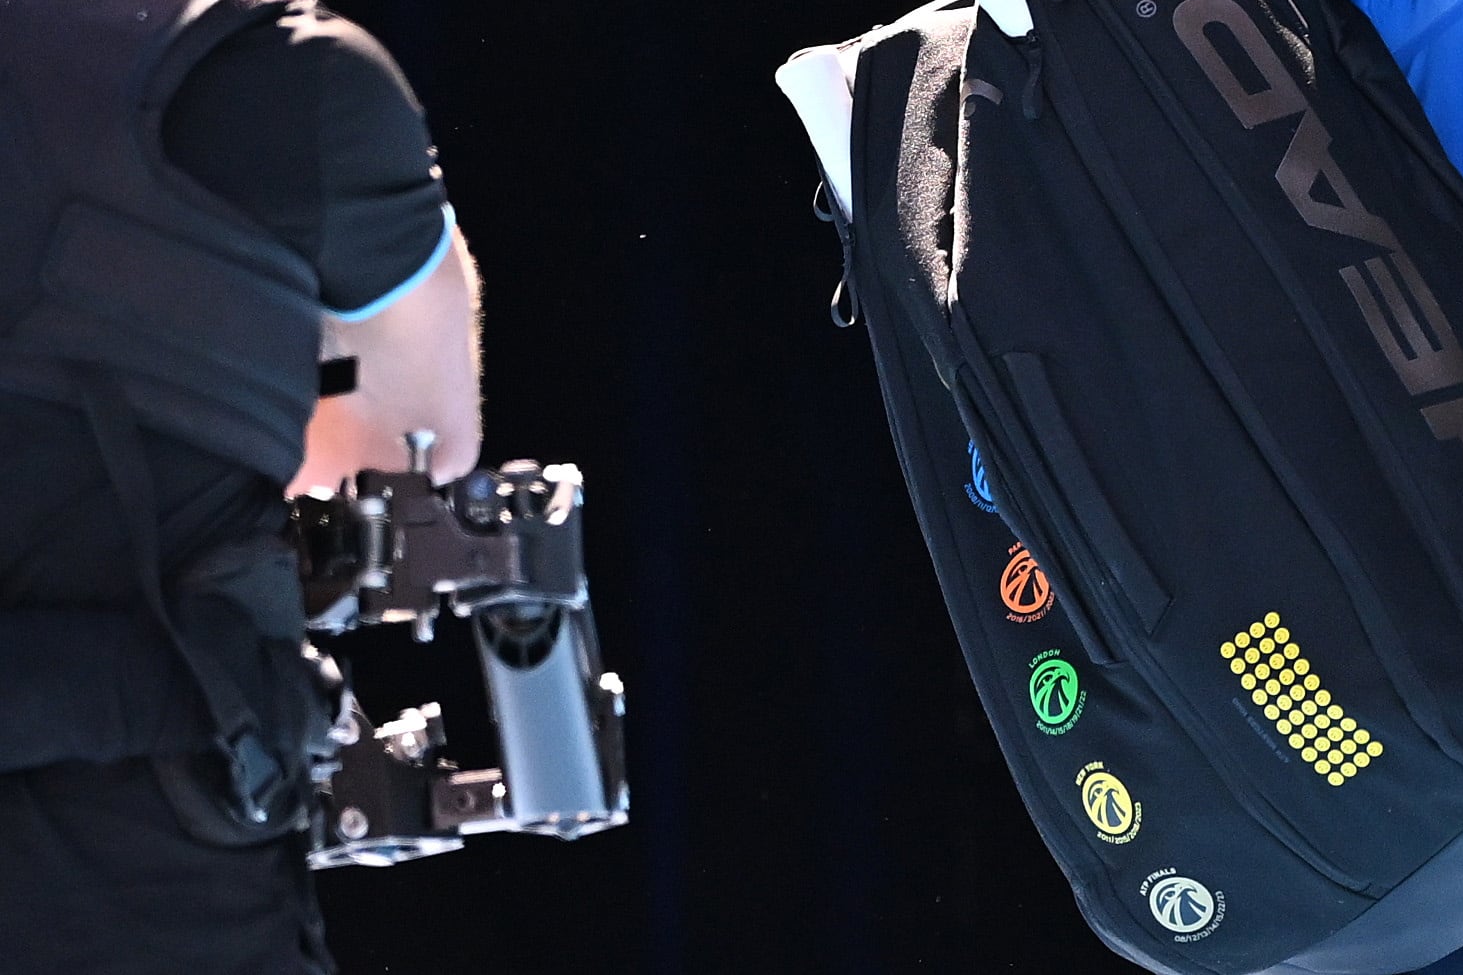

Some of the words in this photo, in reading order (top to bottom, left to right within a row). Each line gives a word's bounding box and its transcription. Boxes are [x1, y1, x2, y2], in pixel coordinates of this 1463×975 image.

[1028, 648, 1061, 669] LONDON
[1139, 880, 1152, 897] ATP
[1147, 867, 1177, 883] FINALS
